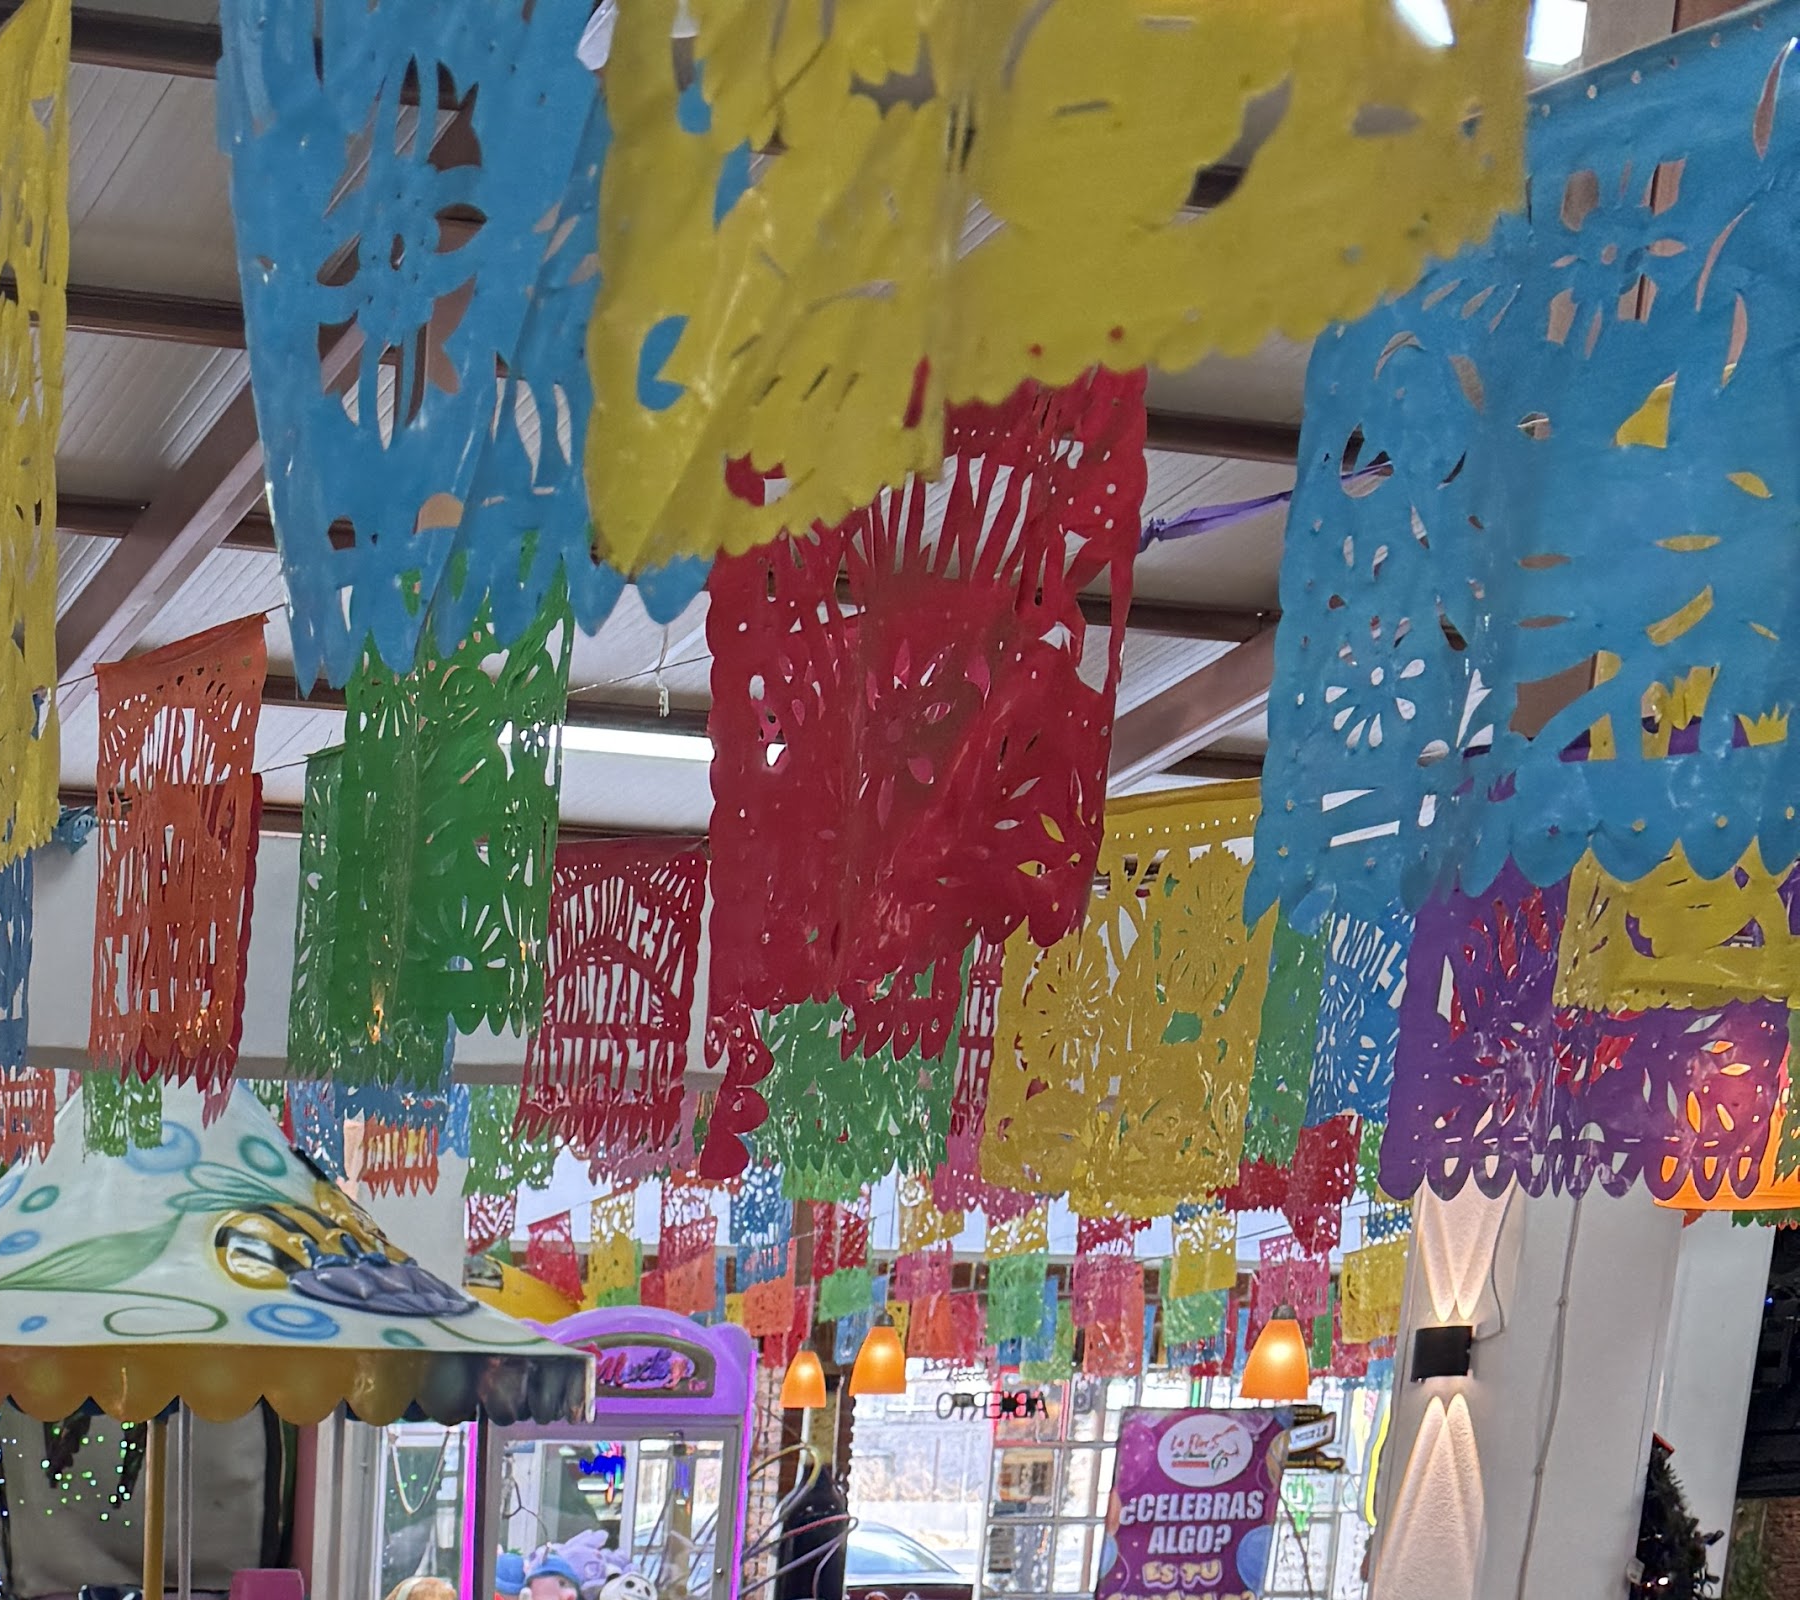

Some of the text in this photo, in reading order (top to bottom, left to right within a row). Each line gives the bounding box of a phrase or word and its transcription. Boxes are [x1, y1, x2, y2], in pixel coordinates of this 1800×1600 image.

[1119, 1491, 1264, 1526] ¿CELEBRAS
[1147, 1525, 1232, 1554] ALGO?
[1144, 1559, 1221, 1583] ES TU
